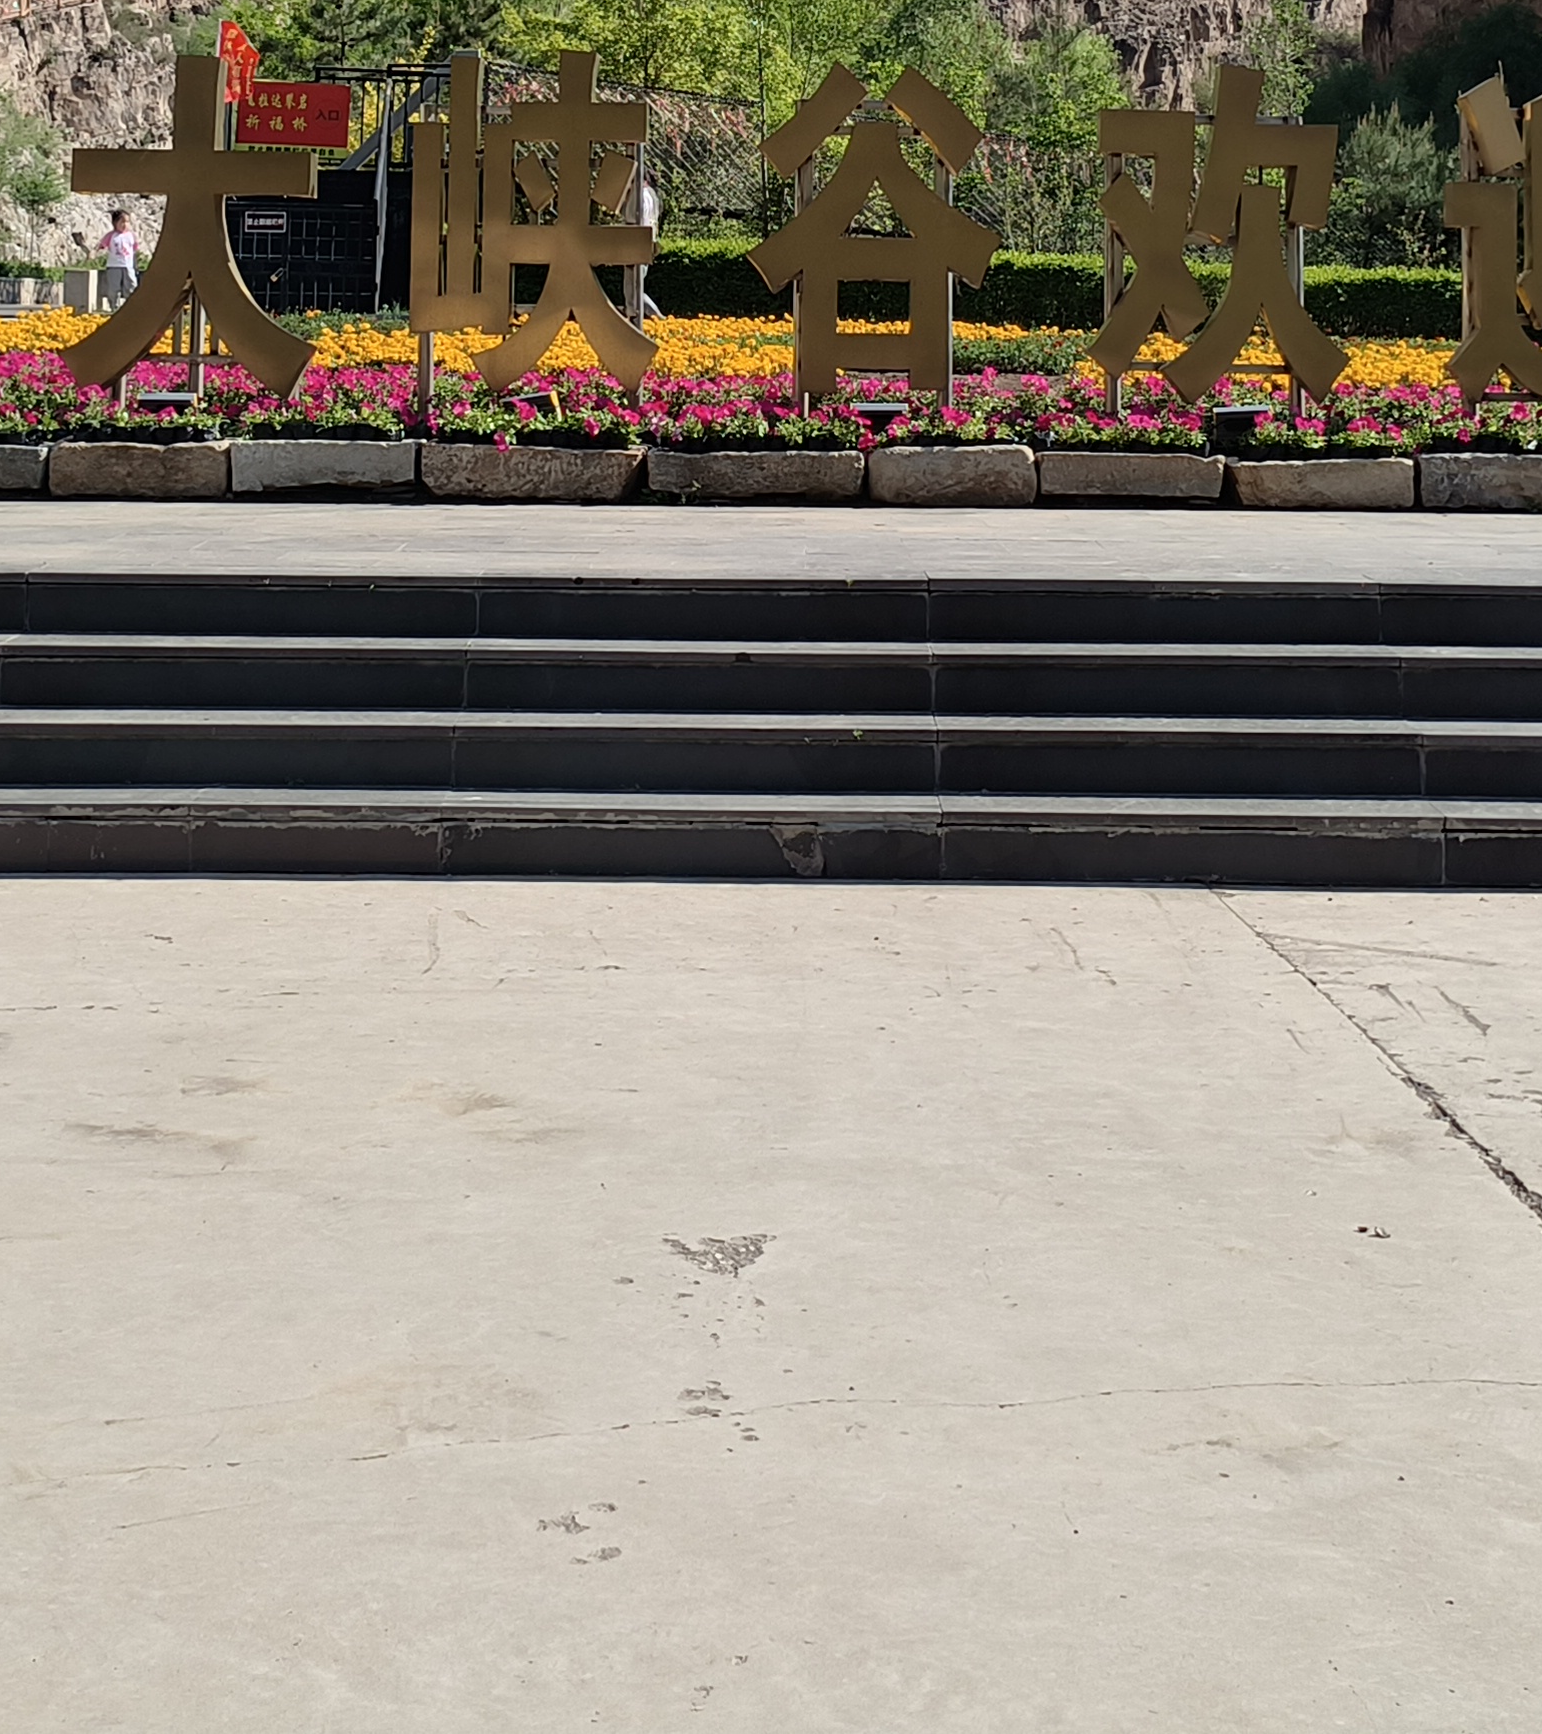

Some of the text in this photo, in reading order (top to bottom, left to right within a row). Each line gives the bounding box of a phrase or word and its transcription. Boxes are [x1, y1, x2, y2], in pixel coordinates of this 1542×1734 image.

[245, 113, 308, 132] 祈福桥
[315, 108, 340, 121] 入口
